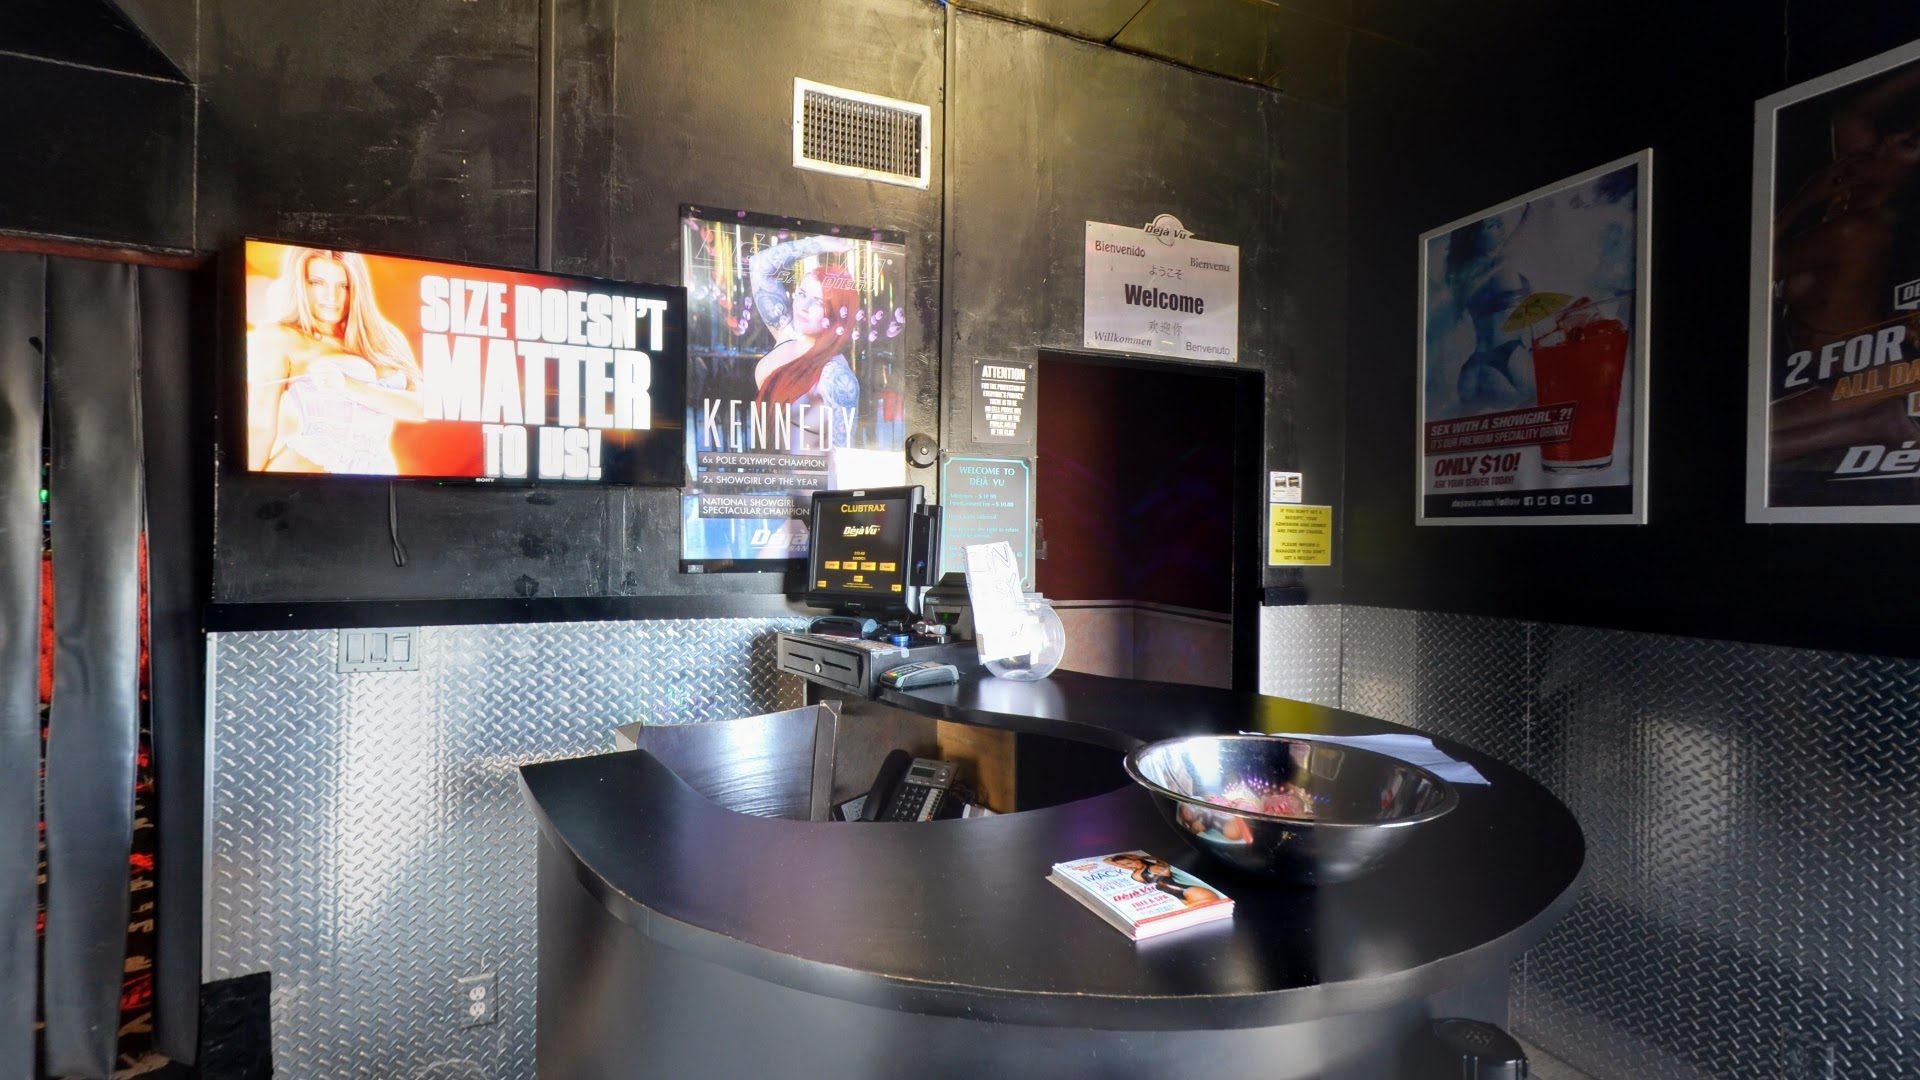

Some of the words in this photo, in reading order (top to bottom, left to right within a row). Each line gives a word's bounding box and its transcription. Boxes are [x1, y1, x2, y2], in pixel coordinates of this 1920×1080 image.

[1145, 225, 1170, 237] Déjà
[1174, 230, 1187, 240] Vu
[1095, 240, 1146, 258] Bienvenido
[1190, 257, 1230, 272] Bienvenu
[1148, 265, 1183, 280] ようこそ
[1125, 284, 1204, 315] Welcome
[420, 275, 508, 338] SIZE
[515, 285, 667, 351] DOESN'T
[1094, 331, 1152, 346] Willkommen
[1186, 342, 1231, 356] Benvenuto
[1784, 350, 1813, 388] 2
[1818, 324, 1907, 381] FOR
[982, 365, 1026, 381] ATTENTION
[422, 333, 651, 430] MATTER
[1832, 367, 1884, 401] ALL
[703, 398, 856, 451] KENNEDY
[1431, 425, 1451, 437] SEX
[1452, 421, 1480, 434] WITH
[1481, 419, 1490, 430] A
[483, 424, 527, 478] TO
[538, 426, 602, 481] US!
[702, 456, 713, 464] 6x
[716, 456, 736, 464] POLE
[739, 456, 776, 466] OLYMPIC
[778, 458, 825, 467] CHAMPION
[1435, 456, 1477, 476] ONLY
[1479, 453, 1521, 475] $10!
[960, 466, 999, 475] WELCOME
[1004, 468, 1015, 476] TO
[716, 476, 762, 485] SHOWGIRL
[764, 477, 776, 485] OF
[779, 478, 794, 486] THE
[797, 478, 818, 486] YEAR
[993, 479, 1005, 487] VU
[1465, 477, 1489, 487] SERVER
[702, 498, 748, 506] NATIONAL
[750, 498, 794, 507] SHOWGIRL
[841, 504, 886, 513] CLUBTRAX
[702, 506, 760, 515] SPECTACULAR
[763, 507, 810, 515] CHAMPION
[843, 526, 864, 537] Déjà
[864, 525, 880, 536] Vu
